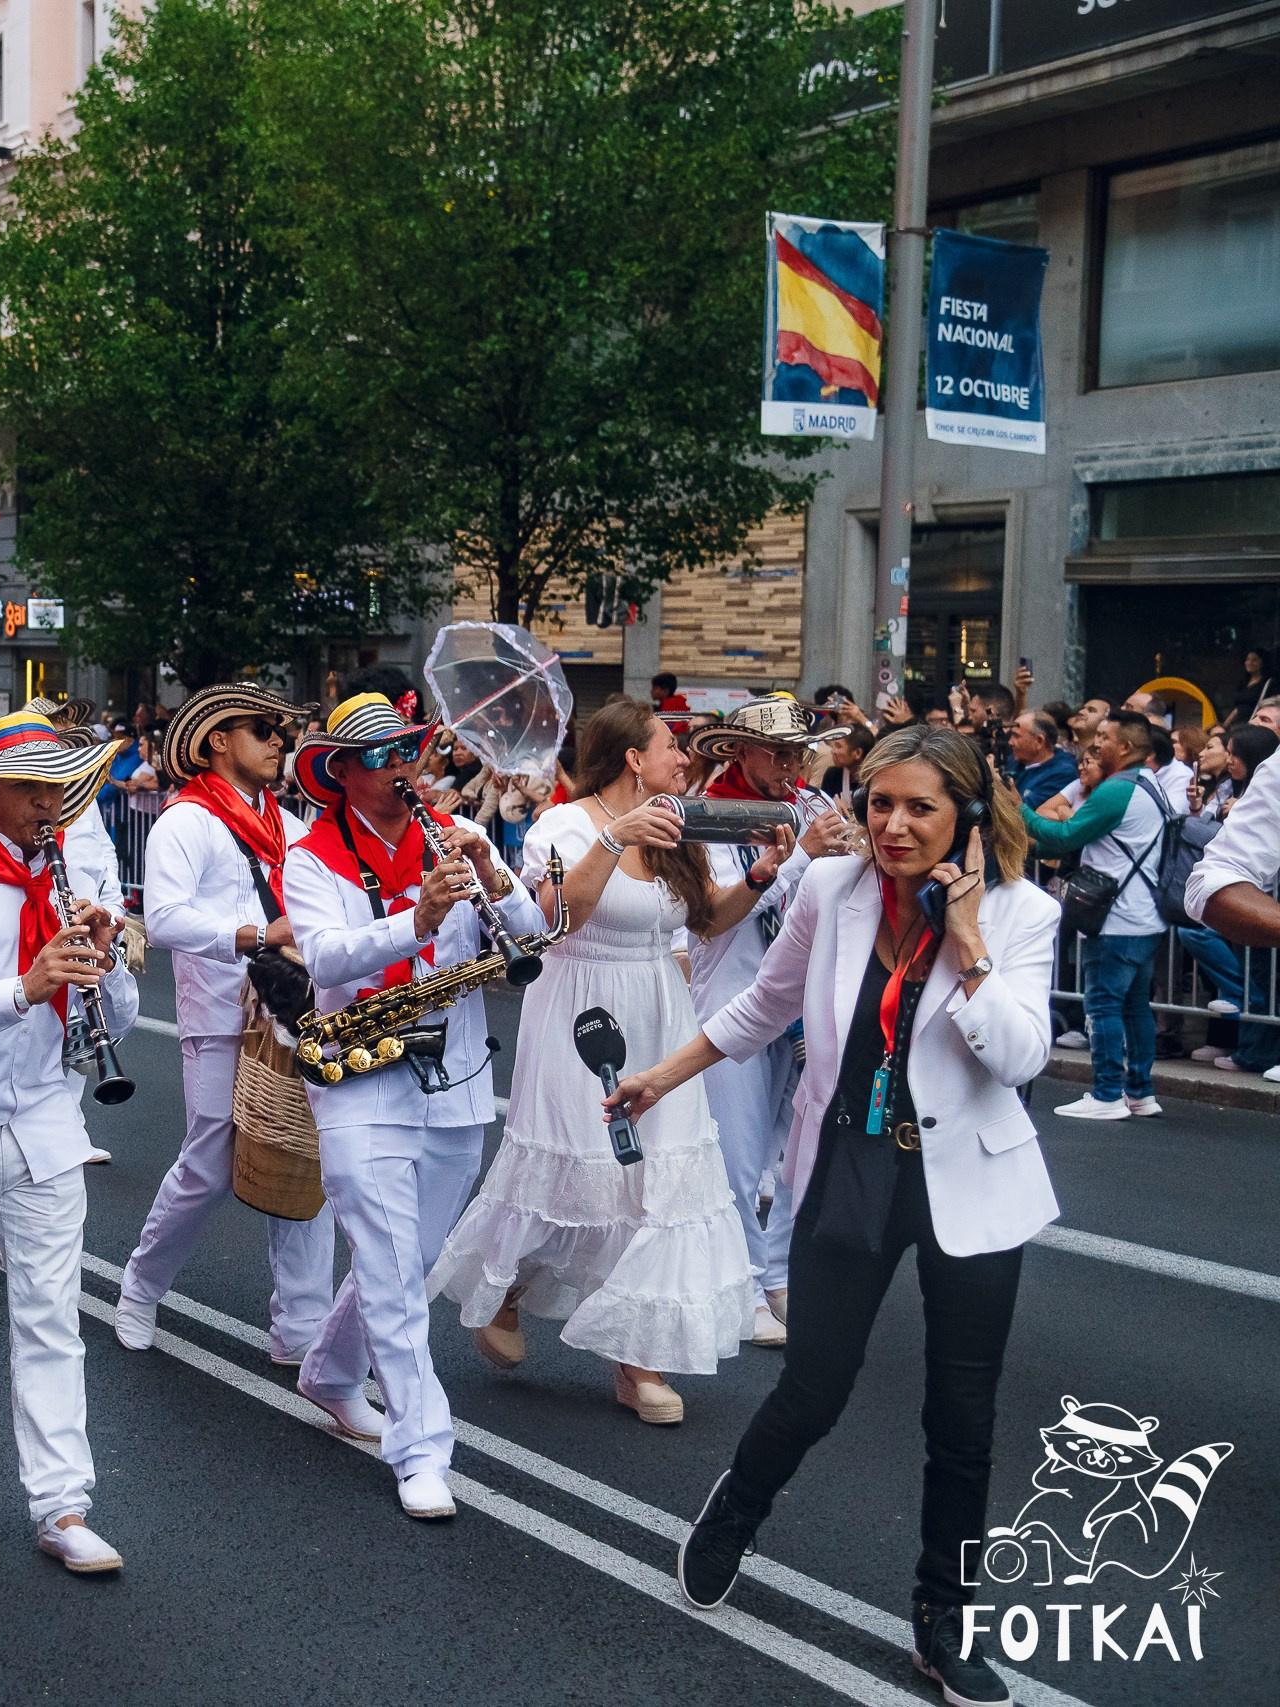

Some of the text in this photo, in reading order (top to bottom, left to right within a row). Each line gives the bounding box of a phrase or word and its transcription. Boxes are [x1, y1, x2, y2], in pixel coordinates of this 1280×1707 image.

[939, 296, 988, 323] FIESTA
[937, 322, 1015, 353] NACIONAL
[935, 375, 1030, 410] 12 OCTUBRE
[808, 414, 856, 433] MADRID
[577, 1019, 601, 1032] MADRID
